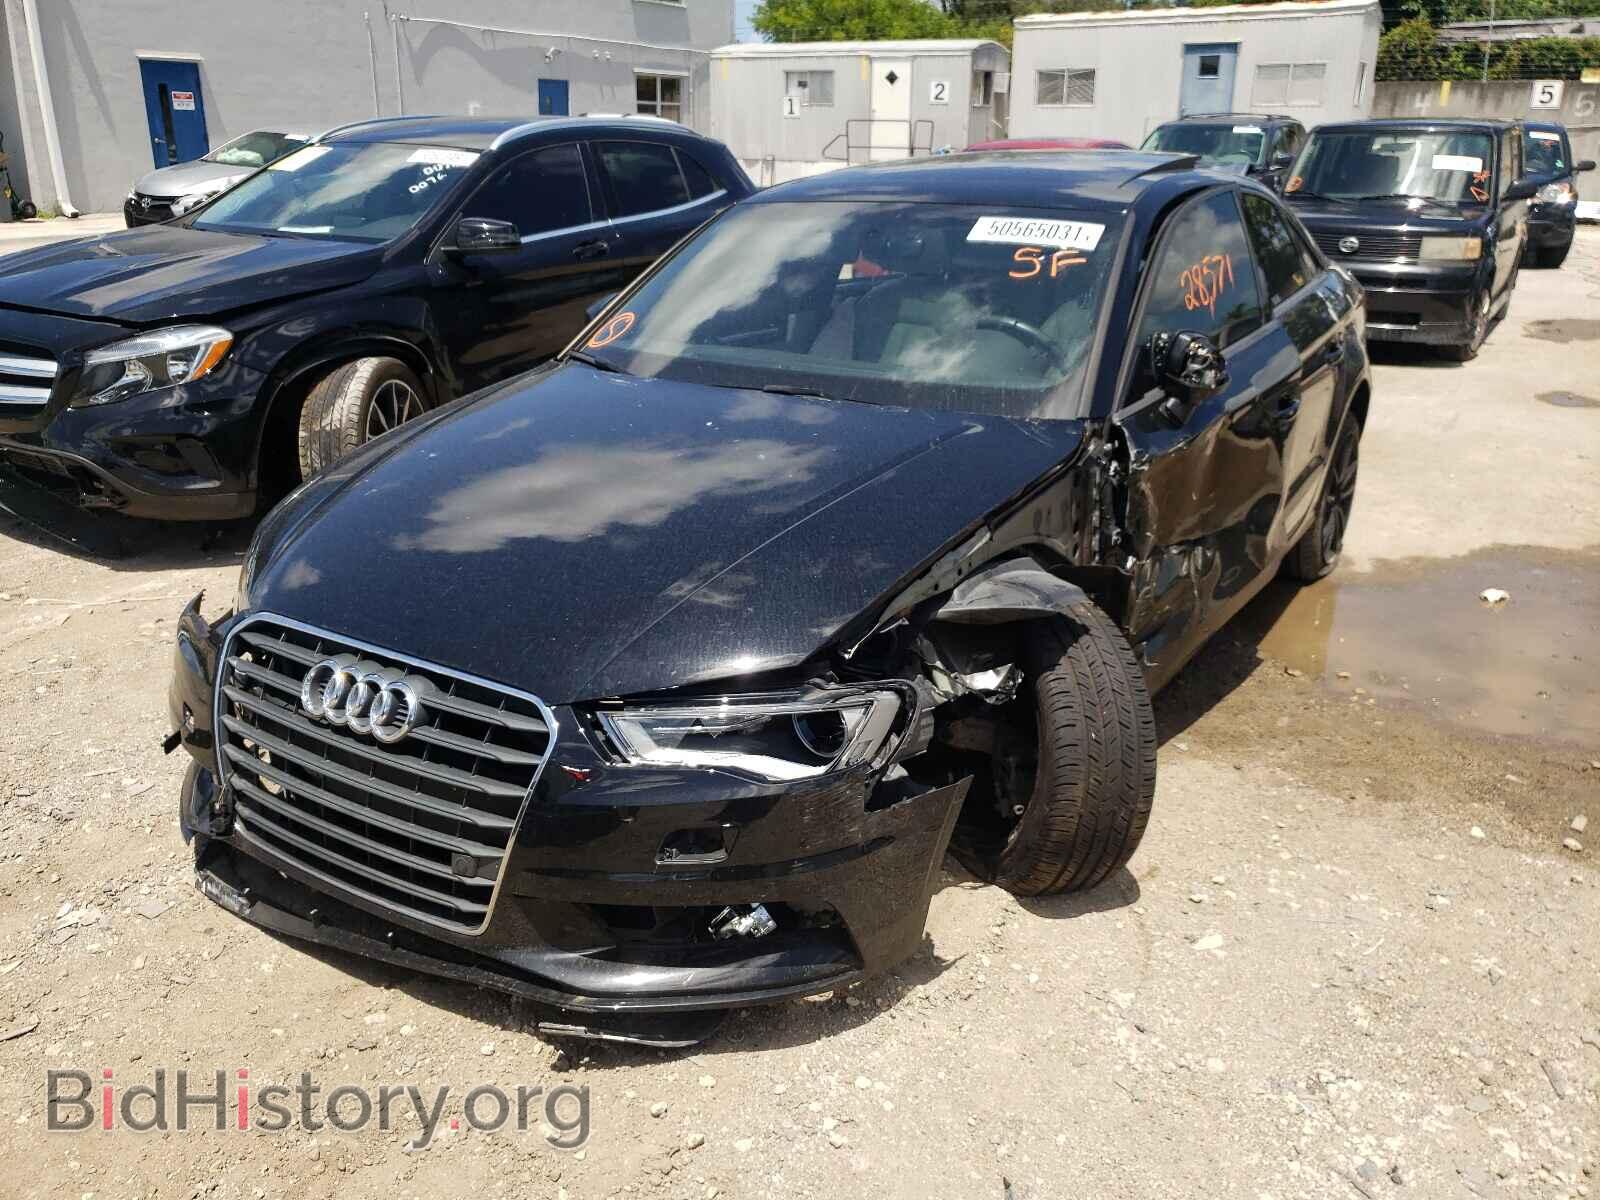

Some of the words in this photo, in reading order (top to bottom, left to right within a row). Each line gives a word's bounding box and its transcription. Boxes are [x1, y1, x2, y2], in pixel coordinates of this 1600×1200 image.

[933, 83, 945, 101] 2
[1540, 85, 1554, 104] 5
[787, 98, 795, 115] 1
[986, 220, 1084, 242] 50565031
